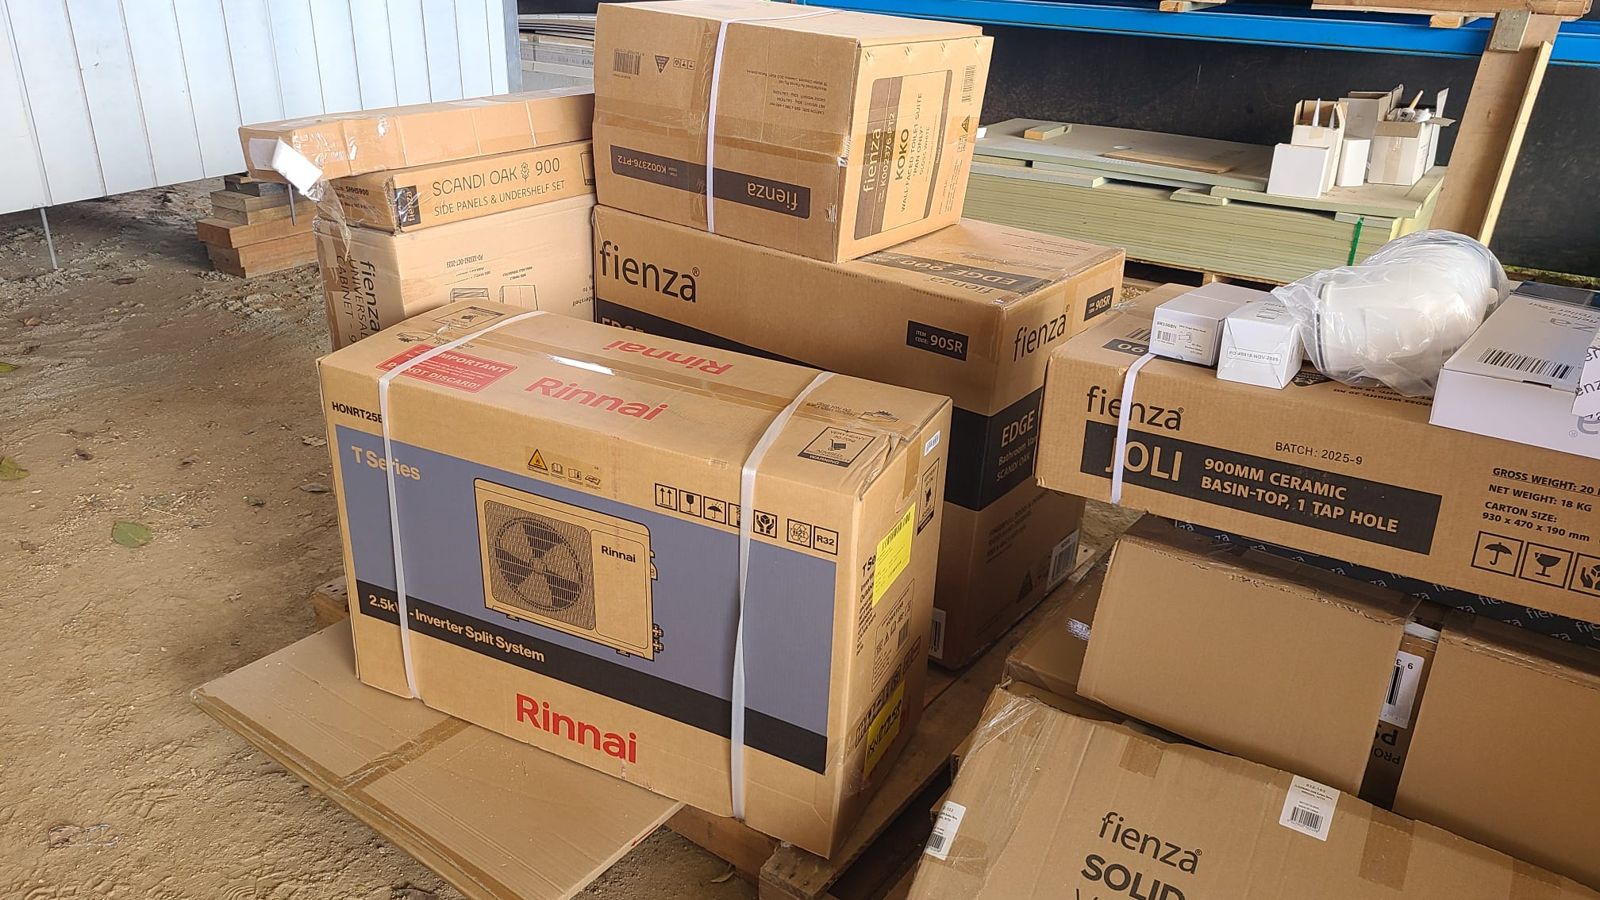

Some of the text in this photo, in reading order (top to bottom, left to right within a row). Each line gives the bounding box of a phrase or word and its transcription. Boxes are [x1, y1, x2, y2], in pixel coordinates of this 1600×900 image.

[863, 128, 882, 193] fienza
[894, 128, 910, 182] KOKO
[432, 157, 561, 197] SCANDI OAK 900
[747, 182, 798, 211] fienza
[434, 179, 566, 217] SIDE PANELS & UNDERSHELF SET
[336, 253, 352, 319] CABINET
[599, 240, 697, 303] fienza
[349, 257, 369, 342] UNIVERSAL
[360, 260, 381, 333] fienza
[1094, 294, 1112, 310] 90SR
[930, 333, 964, 353] 90SR
[1014, 312, 1067, 362] fienza
[602, 340, 734, 375] Rinnai
[428, 371, 481, 389] DISCARD!
[524, 377, 669, 421] Rinnai
[1001, 409, 1035, 448] EDGE
[351, 445, 363, 464] T
[1275, 441, 1363, 466] BATCH: 2025-9
[1204, 457, 1347, 501] 900MM CERAMIC
[1488, 484, 1592, 512] NET WEIGHT: 18 KG
[1492, 467, 1529, 481] GROSS
[1531, 474, 1577, 492] WEIGHT:
[1580, 485, 1594, 495] 20
[1201, 475, 1399, 533] BASIN-TOP, 1 TAP HOLE
[1484, 501, 1557, 523] CARTON SIZE:
[816, 535, 835, 547] R32
[1482, 512, 1502, 522] 930
[1514, 519, 1533, 529] 470
[1546, 526, 1566, 536] 190
[1568, 532, 1590, 542] mm
[600, 545, 637, 563] Rinnai
[415, 608, 464, 635] Inverter
[465, 625, 495, 648] Split
[495, 634, 546, 664] System
[515, 692, 637, 764] Rinnai
[1099, 811, 1199, 875] fienza
